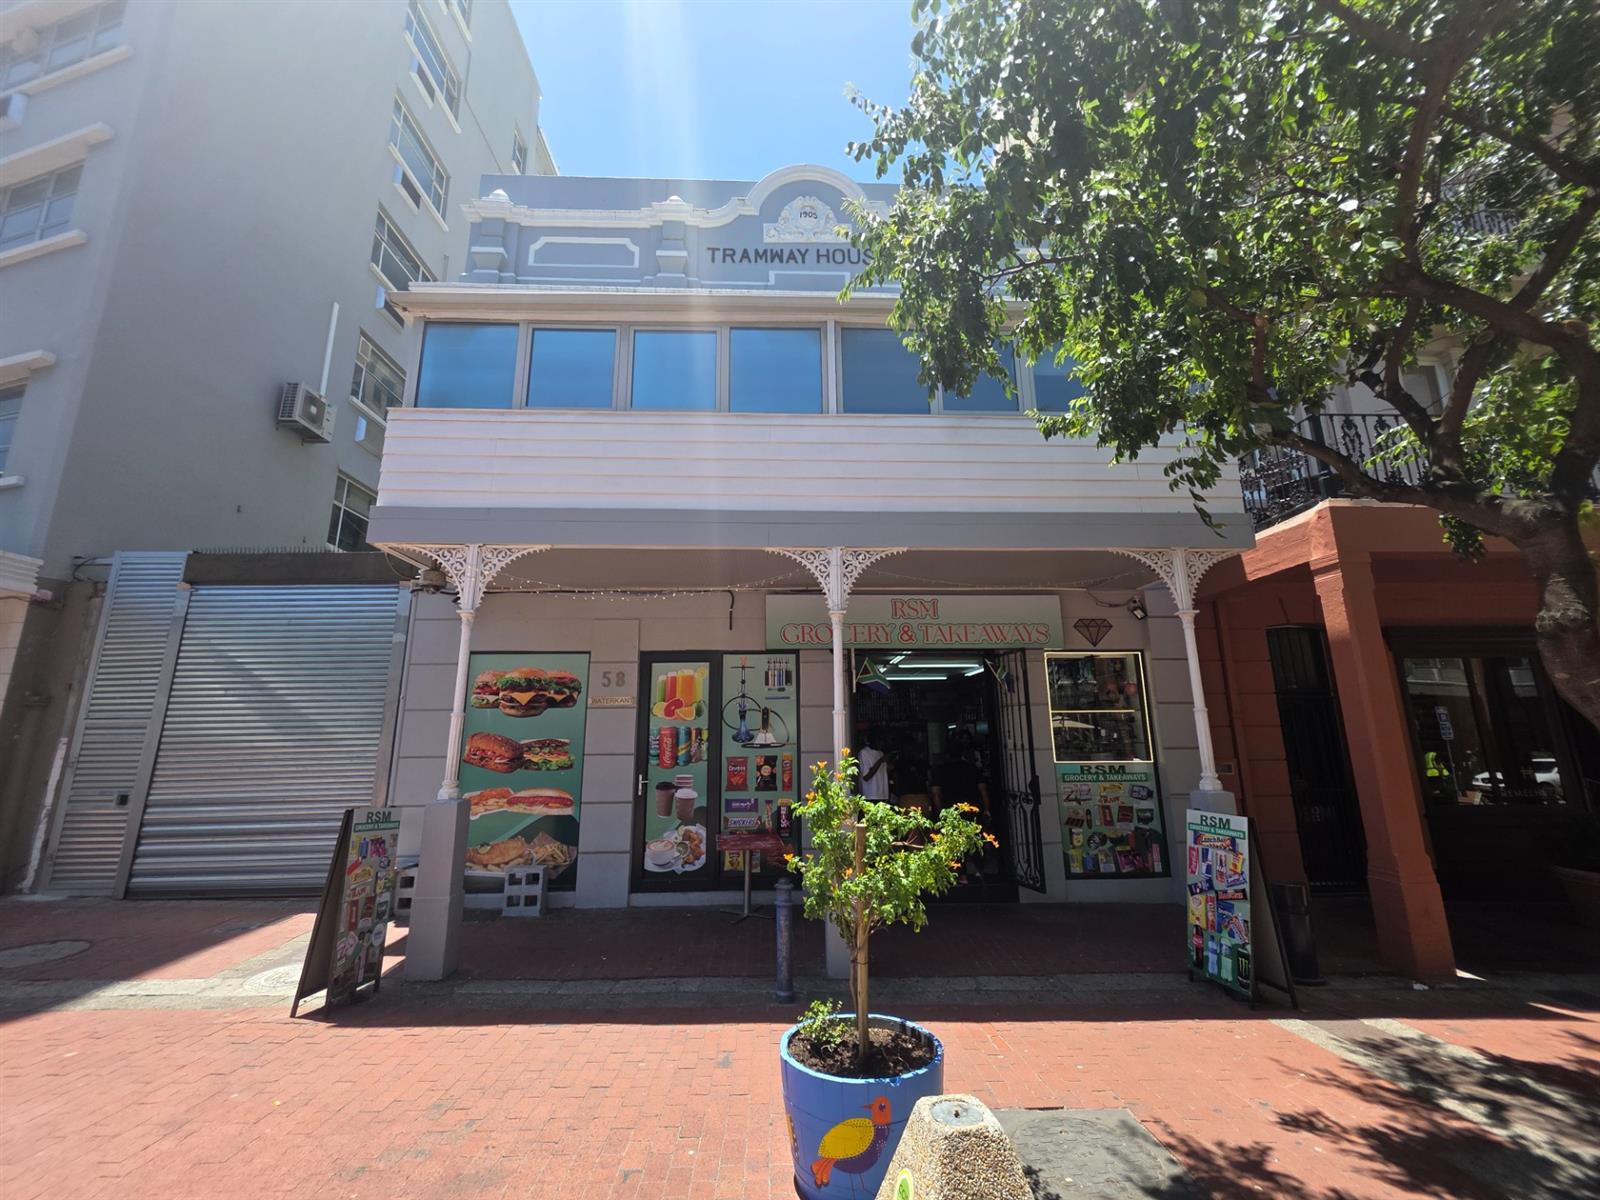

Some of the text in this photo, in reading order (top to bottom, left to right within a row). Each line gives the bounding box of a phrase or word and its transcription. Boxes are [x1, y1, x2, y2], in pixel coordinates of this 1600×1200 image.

[707, 247, 877, 265] TRAMWAY HOUS
[891, 598, 938, 620] RSM
[898, 622, 917, 644] &
[919, 622, 1050, 645] TAKEAWAYS
[601, 671, 626, 688] 58
[1064, 774, 1097, 782] GROCERY
[1106, 773, 1147, 782] TAKEAWAYS
[1080, 765, 1127, 775] RSM
[367, 811, 392, 823] RSM
[1200, 814, 1231, 830] RSM
